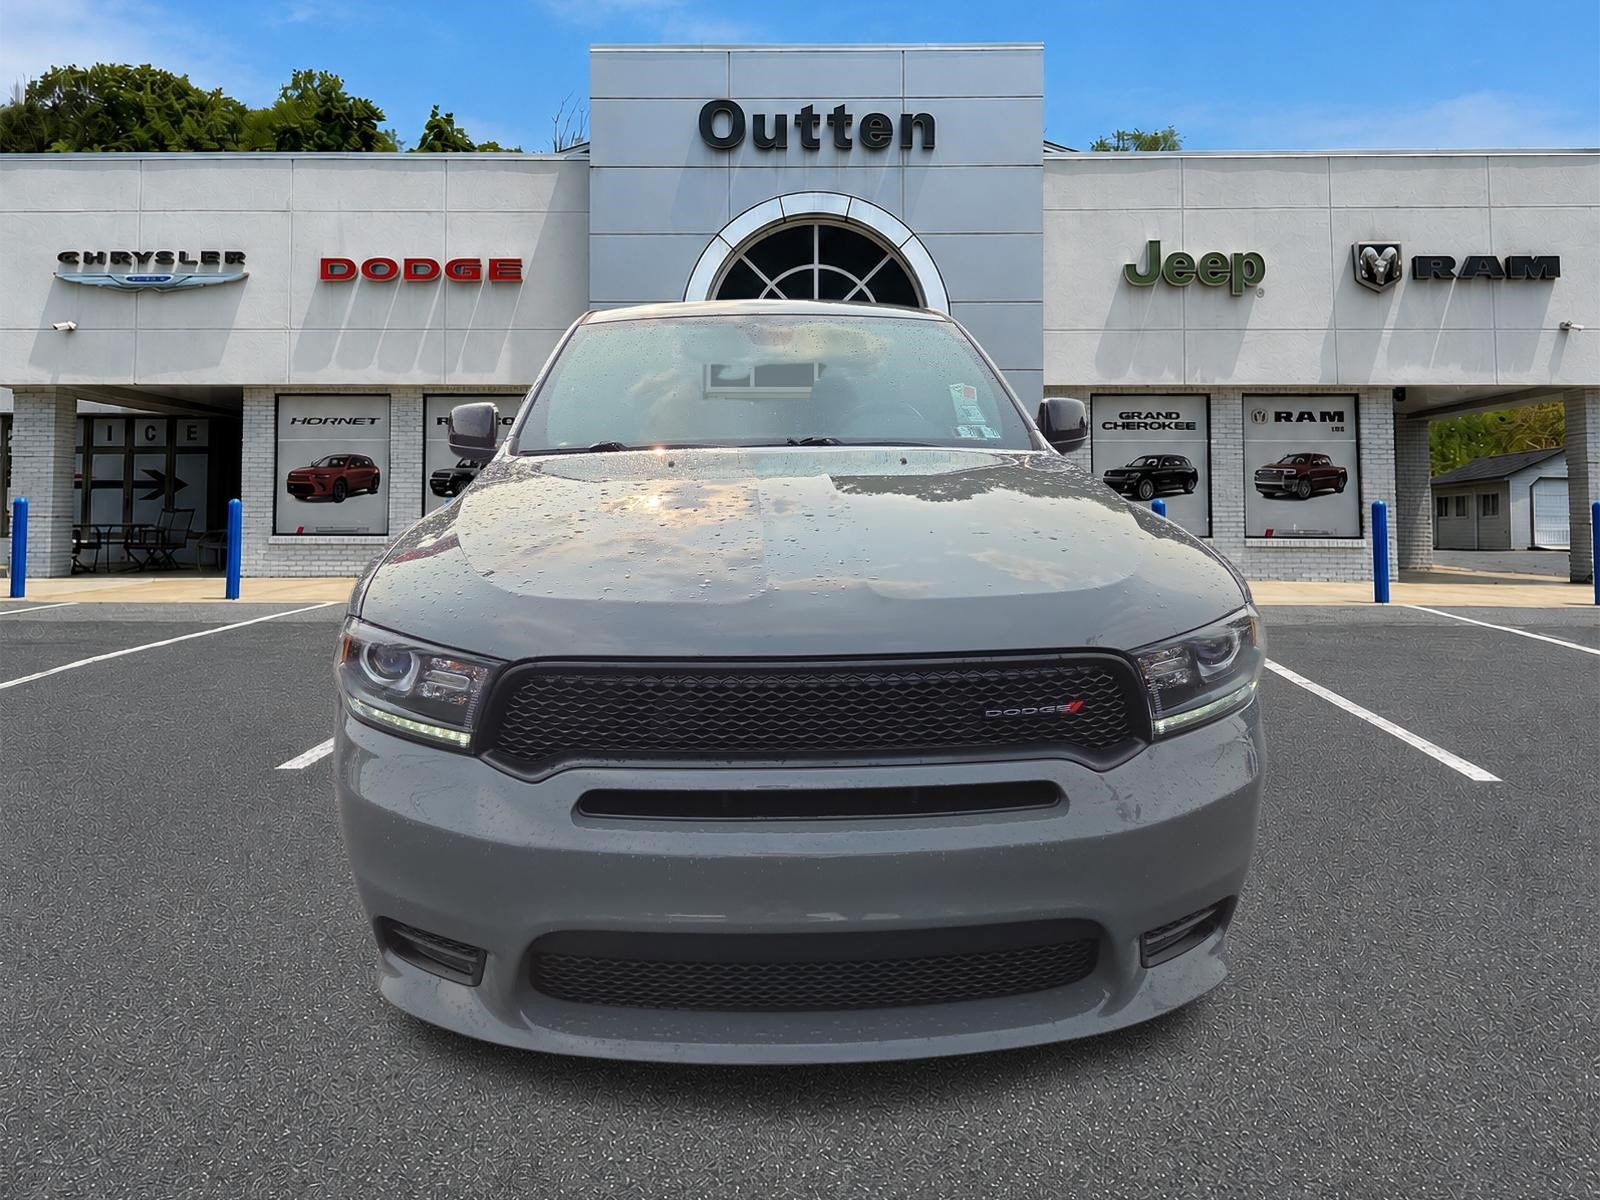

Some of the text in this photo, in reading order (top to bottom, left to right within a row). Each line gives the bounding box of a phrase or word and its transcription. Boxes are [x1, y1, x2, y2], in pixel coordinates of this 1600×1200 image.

[699, 99, 936, 149] Outten
[57, 251, 246, 265] CHRYSLER
[320, 257, 522, 281] DODGE
[1123, 240, 1266, 296] Jeep
[1411, 256, 1560, 280] RAM
[290, 417, 381, 426] HORNET
[1118, 411, 1180, 420] GRAND
[1274, 411, 1345, 423] RAM
[1101, 421, 1196, 431] CHEROKEE
[985, 704, 1071, 717] DODGE
